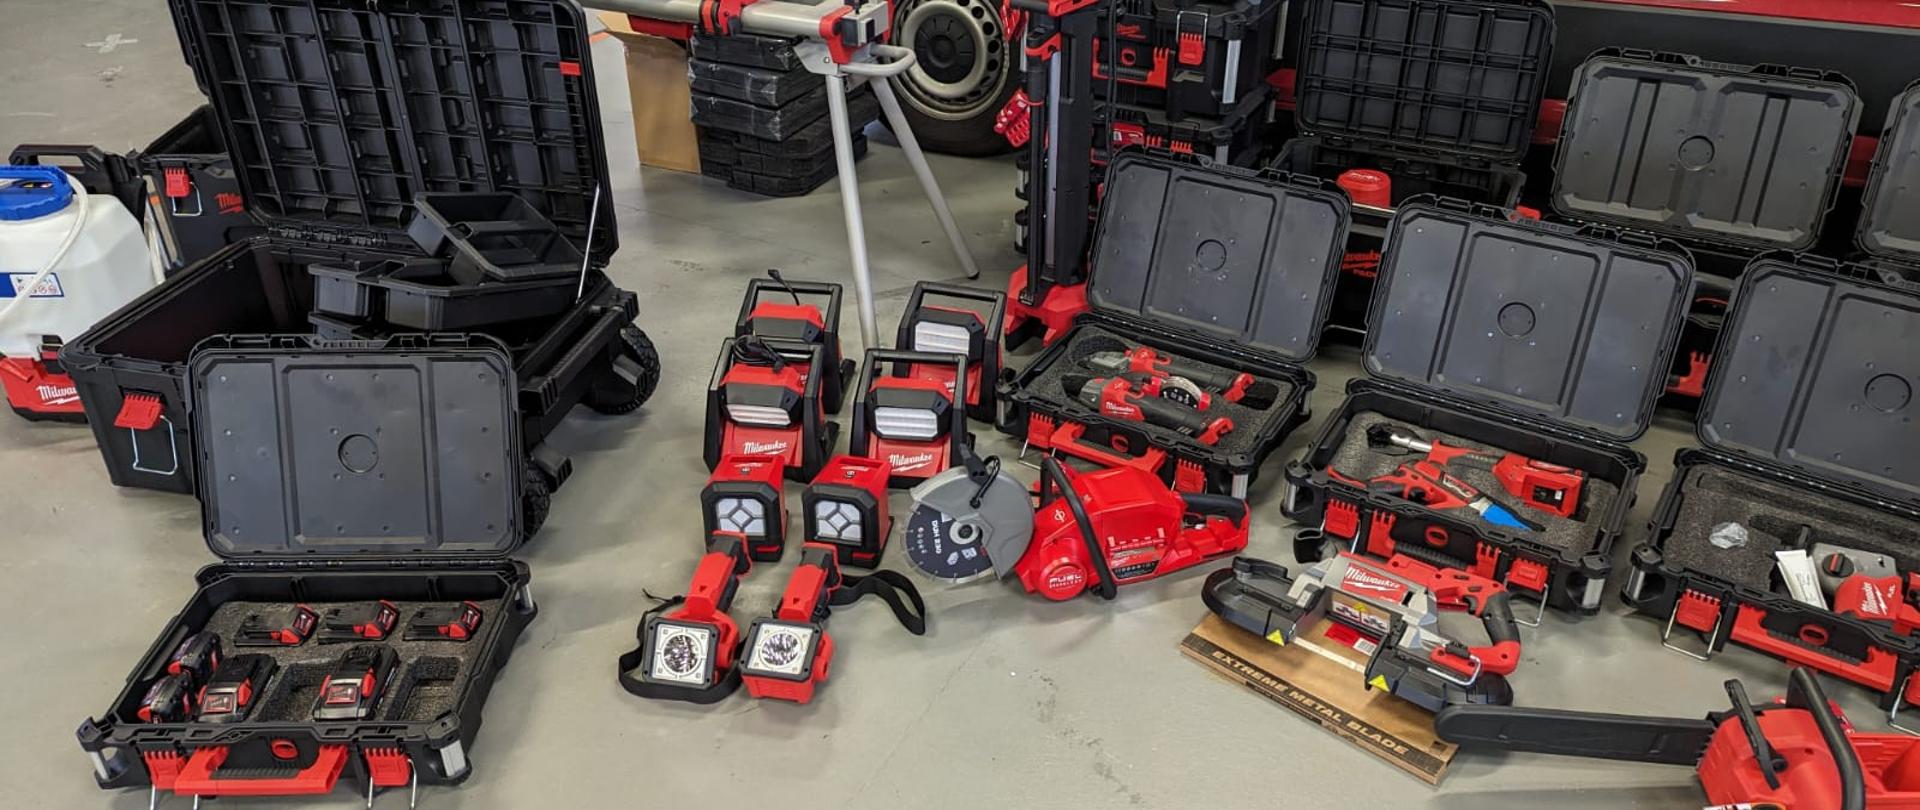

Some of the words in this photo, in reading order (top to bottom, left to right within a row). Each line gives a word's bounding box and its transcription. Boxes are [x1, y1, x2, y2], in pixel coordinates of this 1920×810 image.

[743, 440, 788, 455] Milwaukee
[889, 452, 932, 468] Milwaukee
[1049, 574, 1082, 587] FUEL
[1344, 566, 1401, 589] Milwaukee
[1211, 650, 1289, 692] EXTREME
[1288, 690, 1342, 723] METAL
[1346, 721, 1410, 755] BLADE
